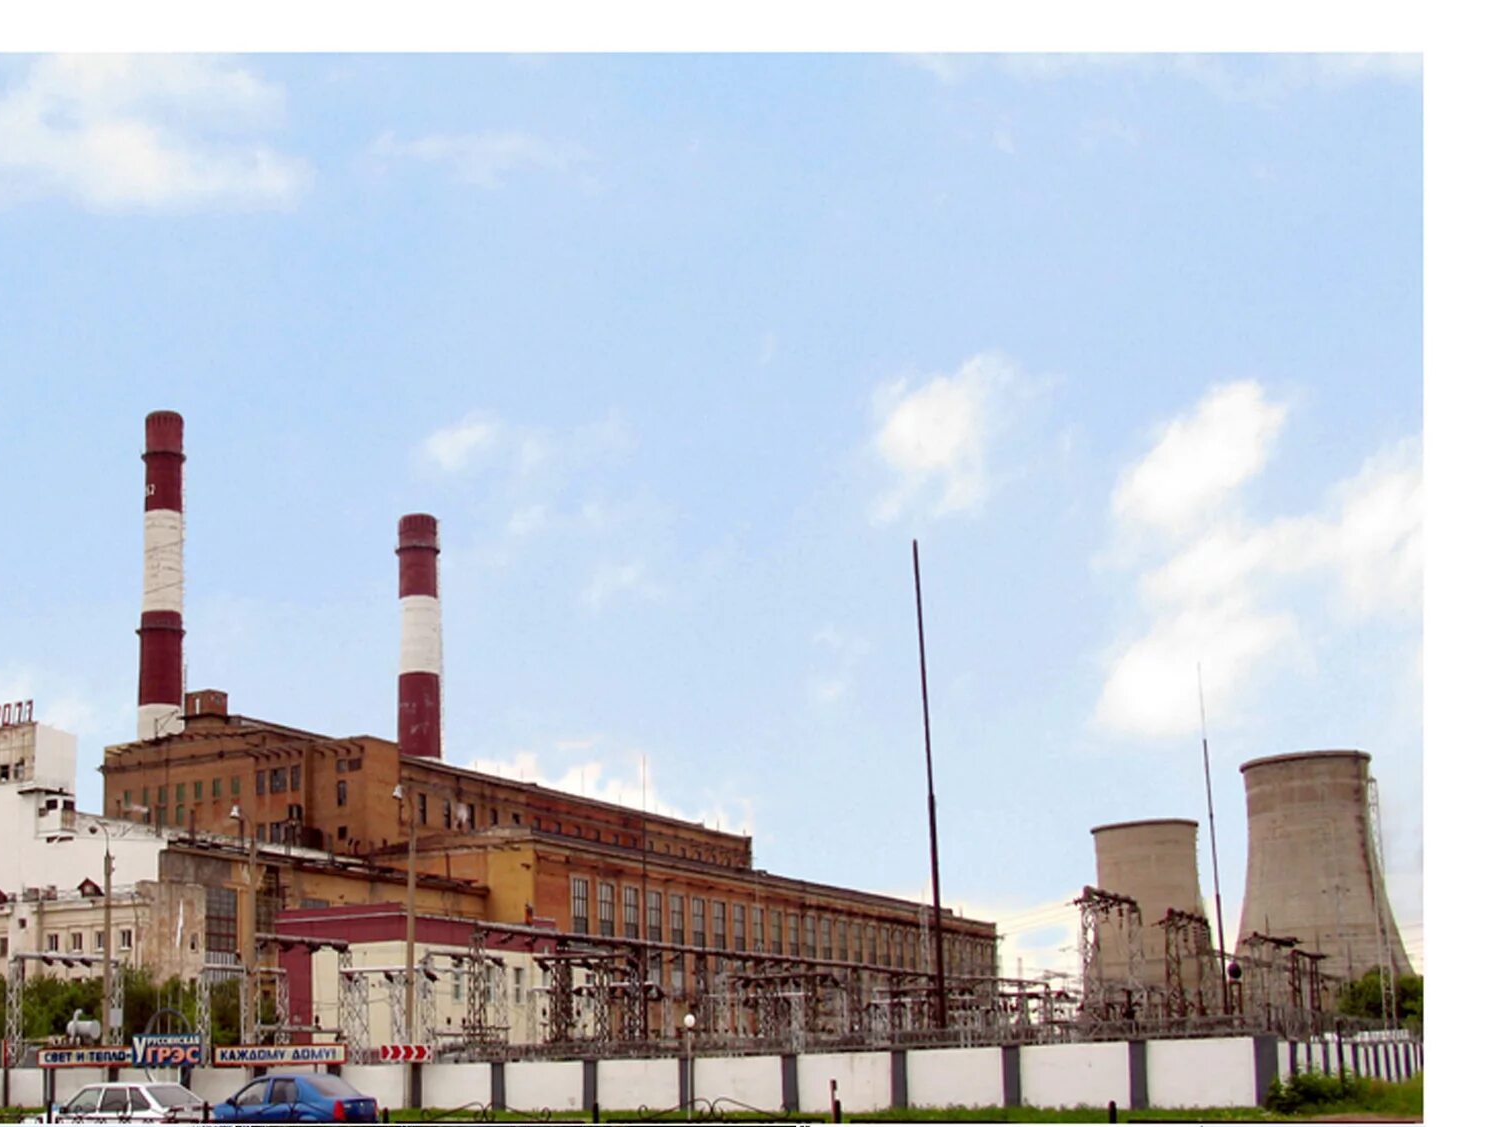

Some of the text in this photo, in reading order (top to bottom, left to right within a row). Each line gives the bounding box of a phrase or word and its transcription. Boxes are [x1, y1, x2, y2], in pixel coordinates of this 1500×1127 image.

[44, 1051, 73, 1063] СВЕТ
[75, 1051, 84, 1062] И
[146, 1046, 200, 1063] ГРЭС
[220, 1048, 286, 1061] КАЖДОМУ
